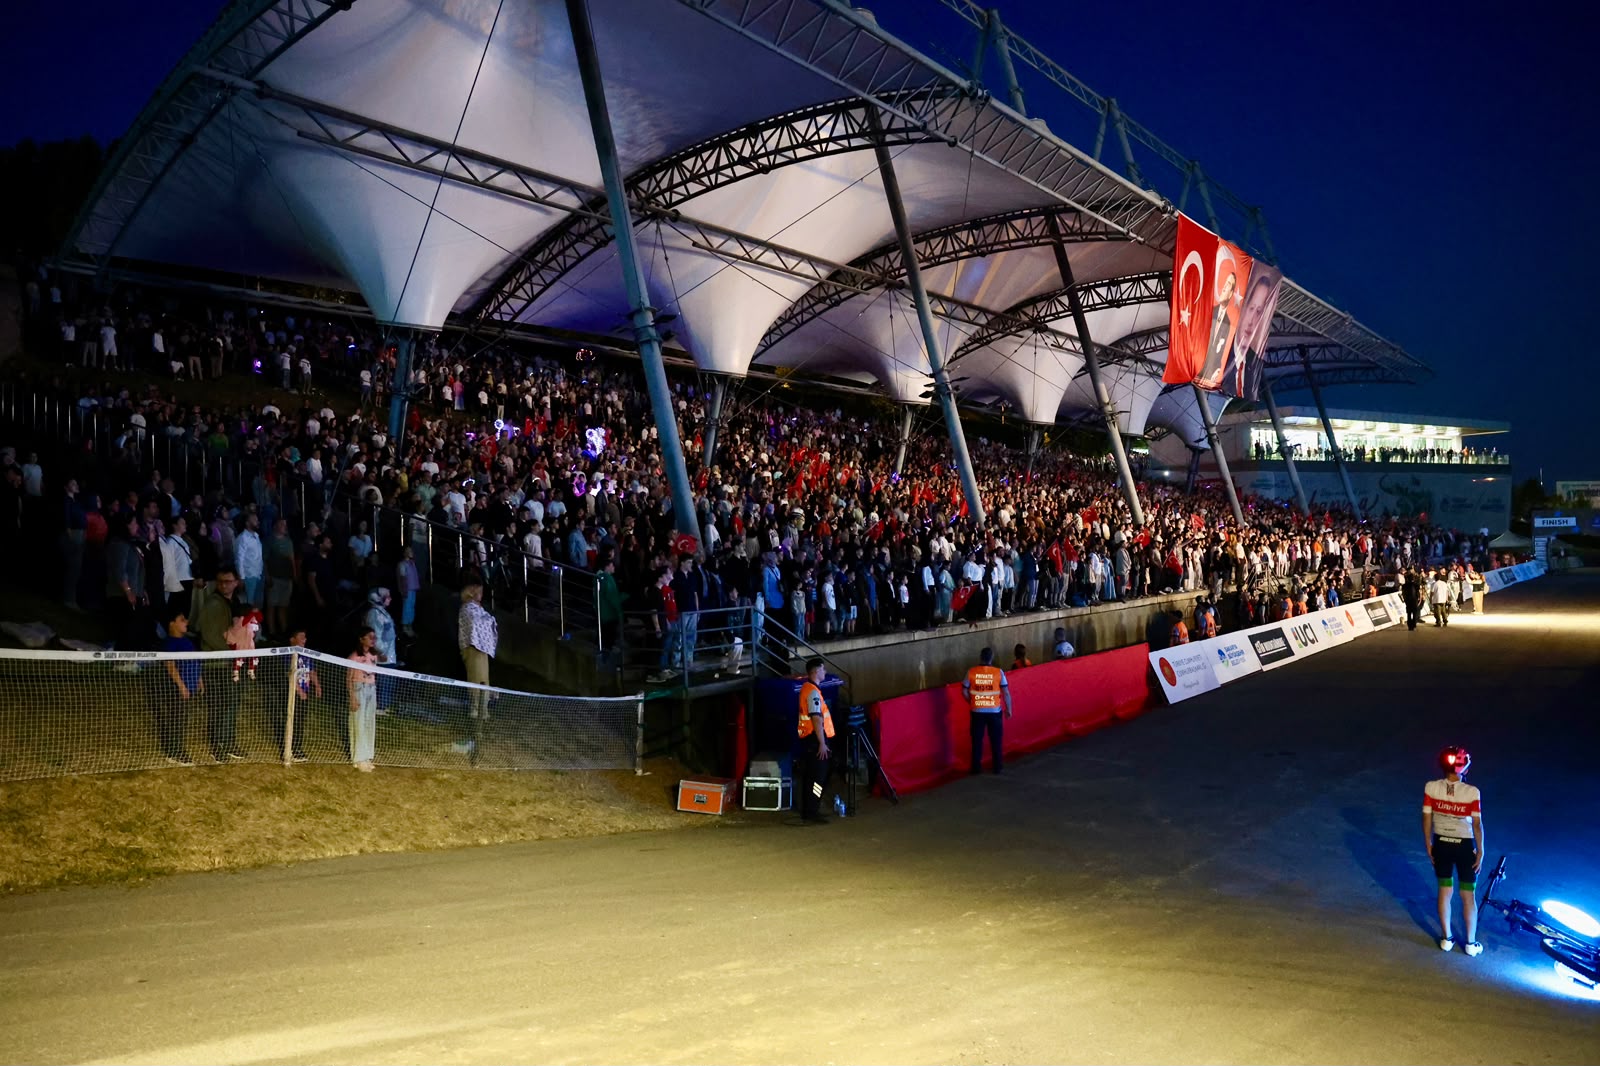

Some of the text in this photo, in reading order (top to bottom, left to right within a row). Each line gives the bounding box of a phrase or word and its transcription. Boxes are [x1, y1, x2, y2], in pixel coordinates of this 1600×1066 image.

[1542, 518, 1568, 526] FINISH
[1295, 623, 1319, 647] UCI
[1436, 801, 1466, 812] ÜRKİYE
